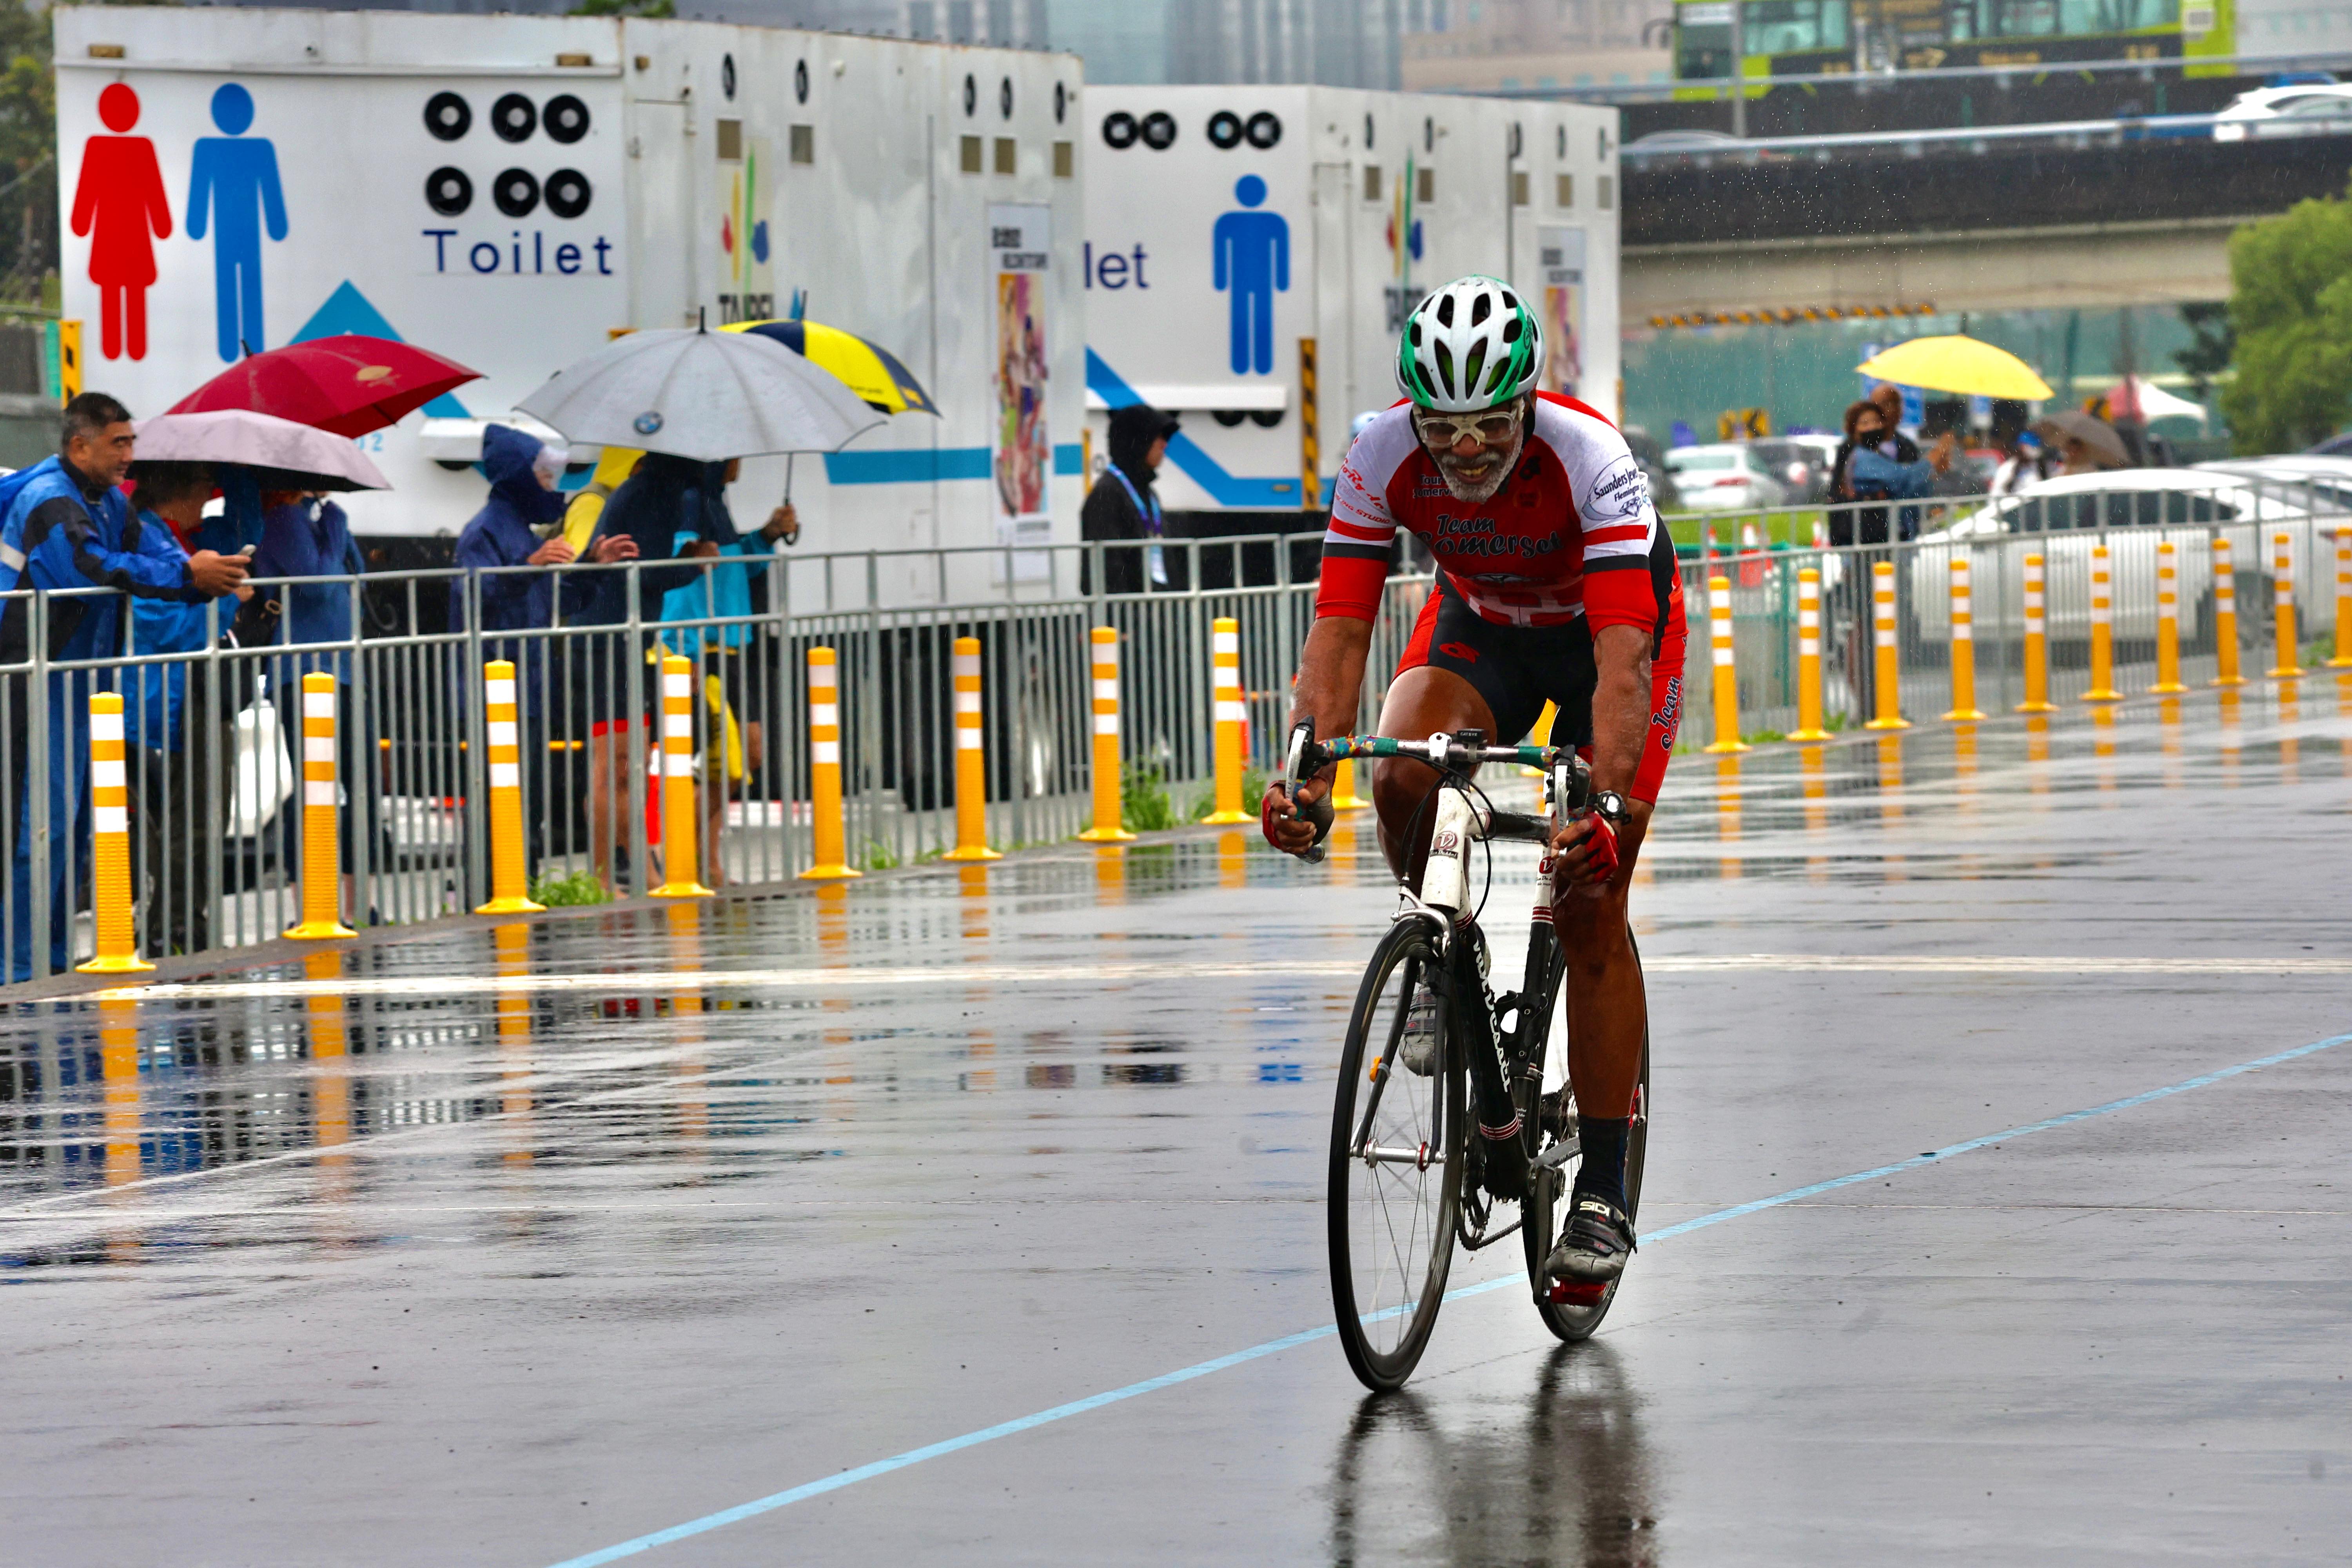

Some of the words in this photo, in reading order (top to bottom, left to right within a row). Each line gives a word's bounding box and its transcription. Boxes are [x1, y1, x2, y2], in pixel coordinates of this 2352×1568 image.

[422, 229, 613, 275] Toilet
[1084, 241, 1149, 289] let
[1594, 473, 1628, 500] Saunders
[1355, 509, 1391, 524] STUDIO
[1437, 514, 1495, 536] Team
[1651, 676, 1681, 729] Team
[1579, 1201, 1610, 1217] SIDI
